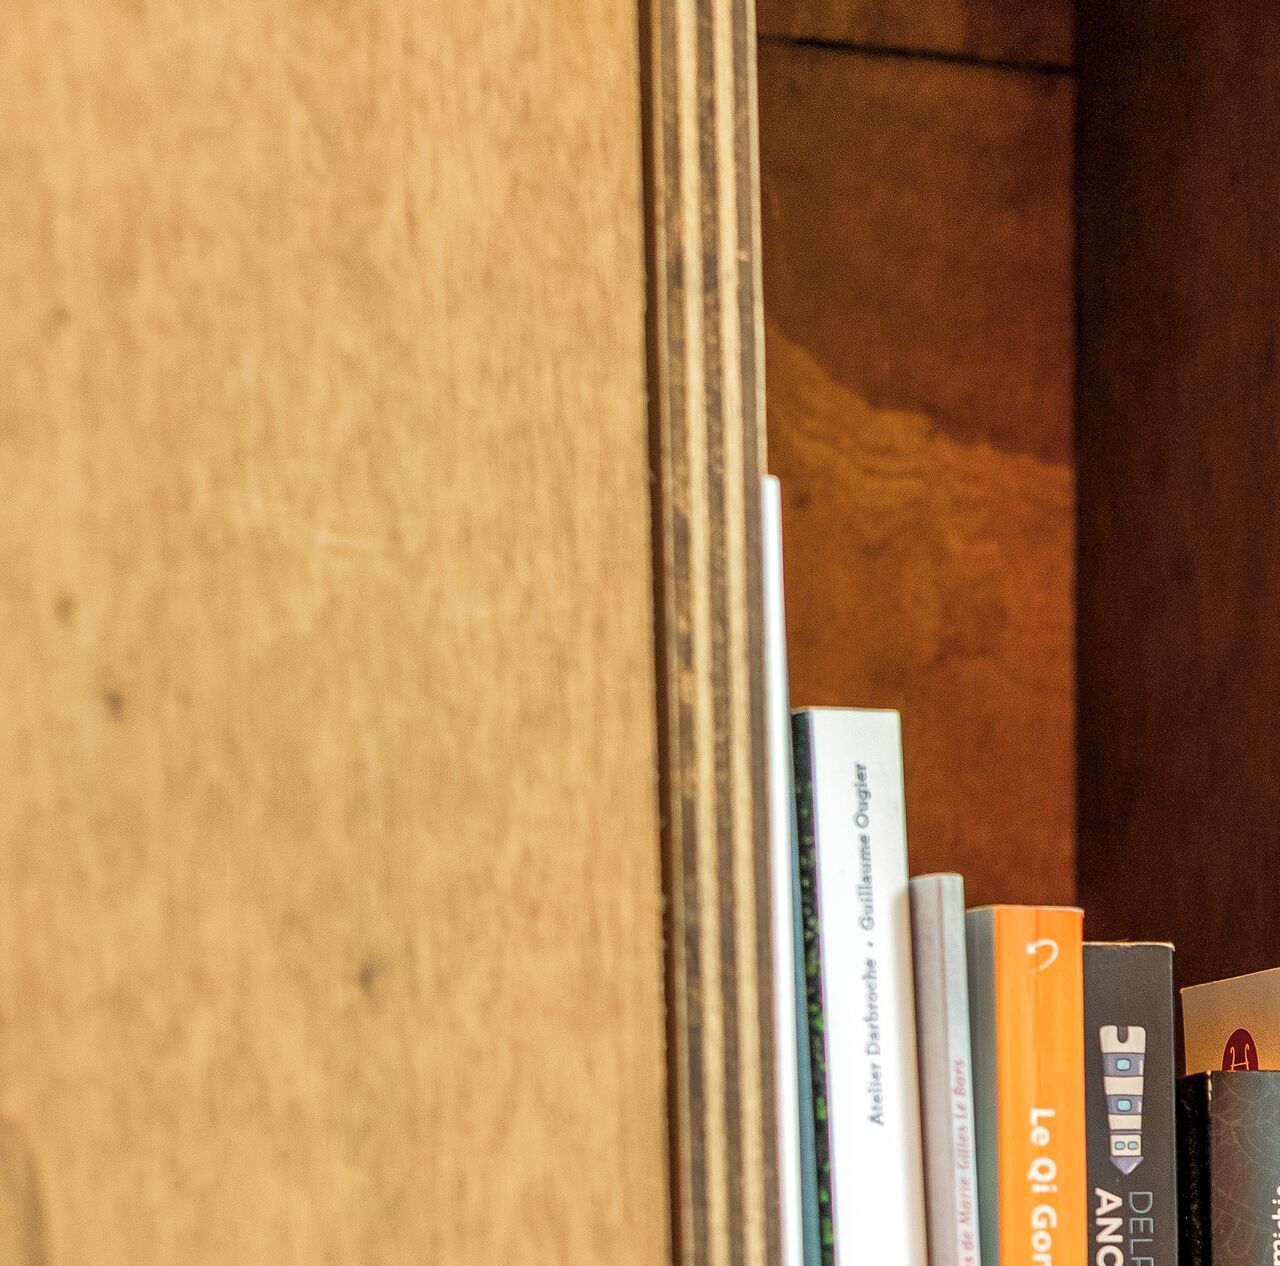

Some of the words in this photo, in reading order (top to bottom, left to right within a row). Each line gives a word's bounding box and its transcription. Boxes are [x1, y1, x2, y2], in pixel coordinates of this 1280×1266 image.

[854, 762, 870, 829] Ougier
[858, 835, 873, 932] Guillaume
[862, 957, 879, 1056] Darbroche
[865, 1063, 883, 1126] Atelier
[1029, 1108, 1056, 1147] Le
[1027, 1157, 1058, 1193] Qi
